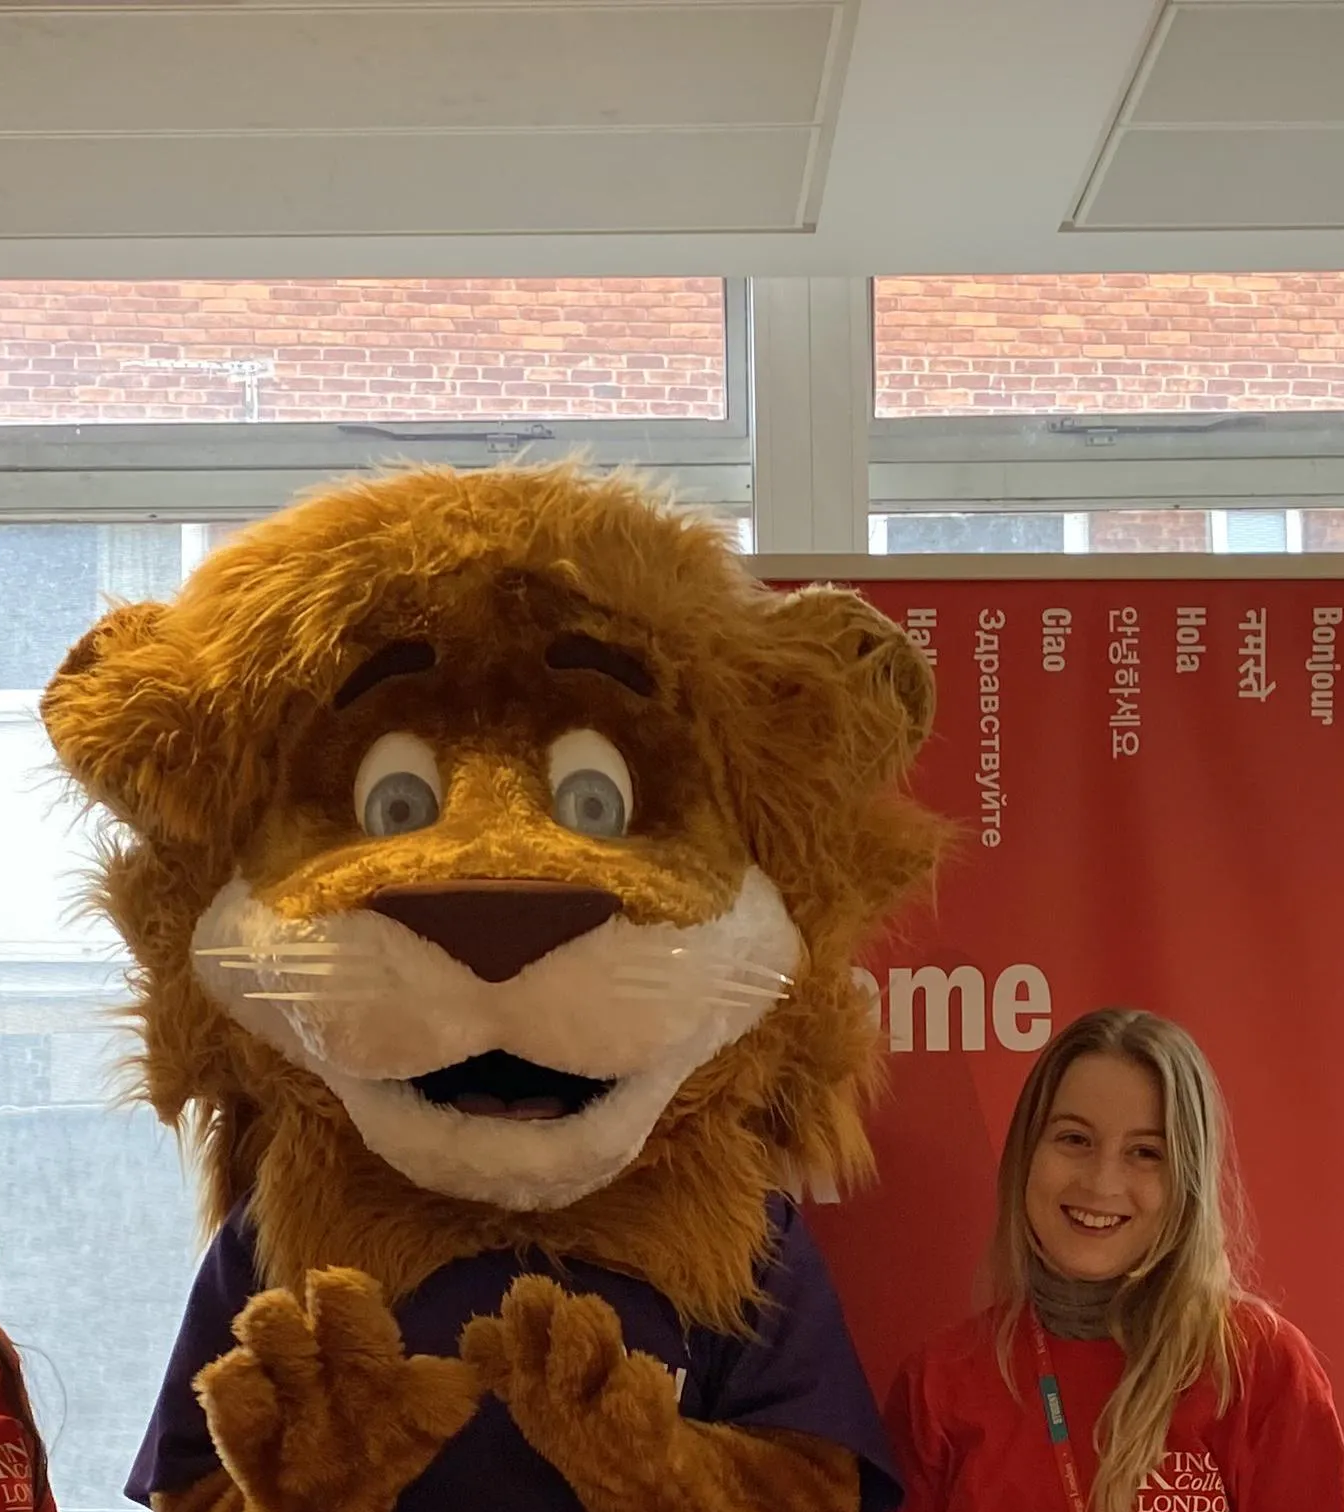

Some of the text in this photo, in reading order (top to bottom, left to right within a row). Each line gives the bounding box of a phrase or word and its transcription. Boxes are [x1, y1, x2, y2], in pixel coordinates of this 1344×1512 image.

[1042, 607, 1072, 672] Ciao
[1108, 606, 1142, 759] 안녕하세요
[1176, 606, 1207, 674] Hola
[1238, 607, 1276, 701] नमस्ते
[1305, 606, 1344, 726] Bonjour
[974, 608, 1007, 848] Здравствуйте
